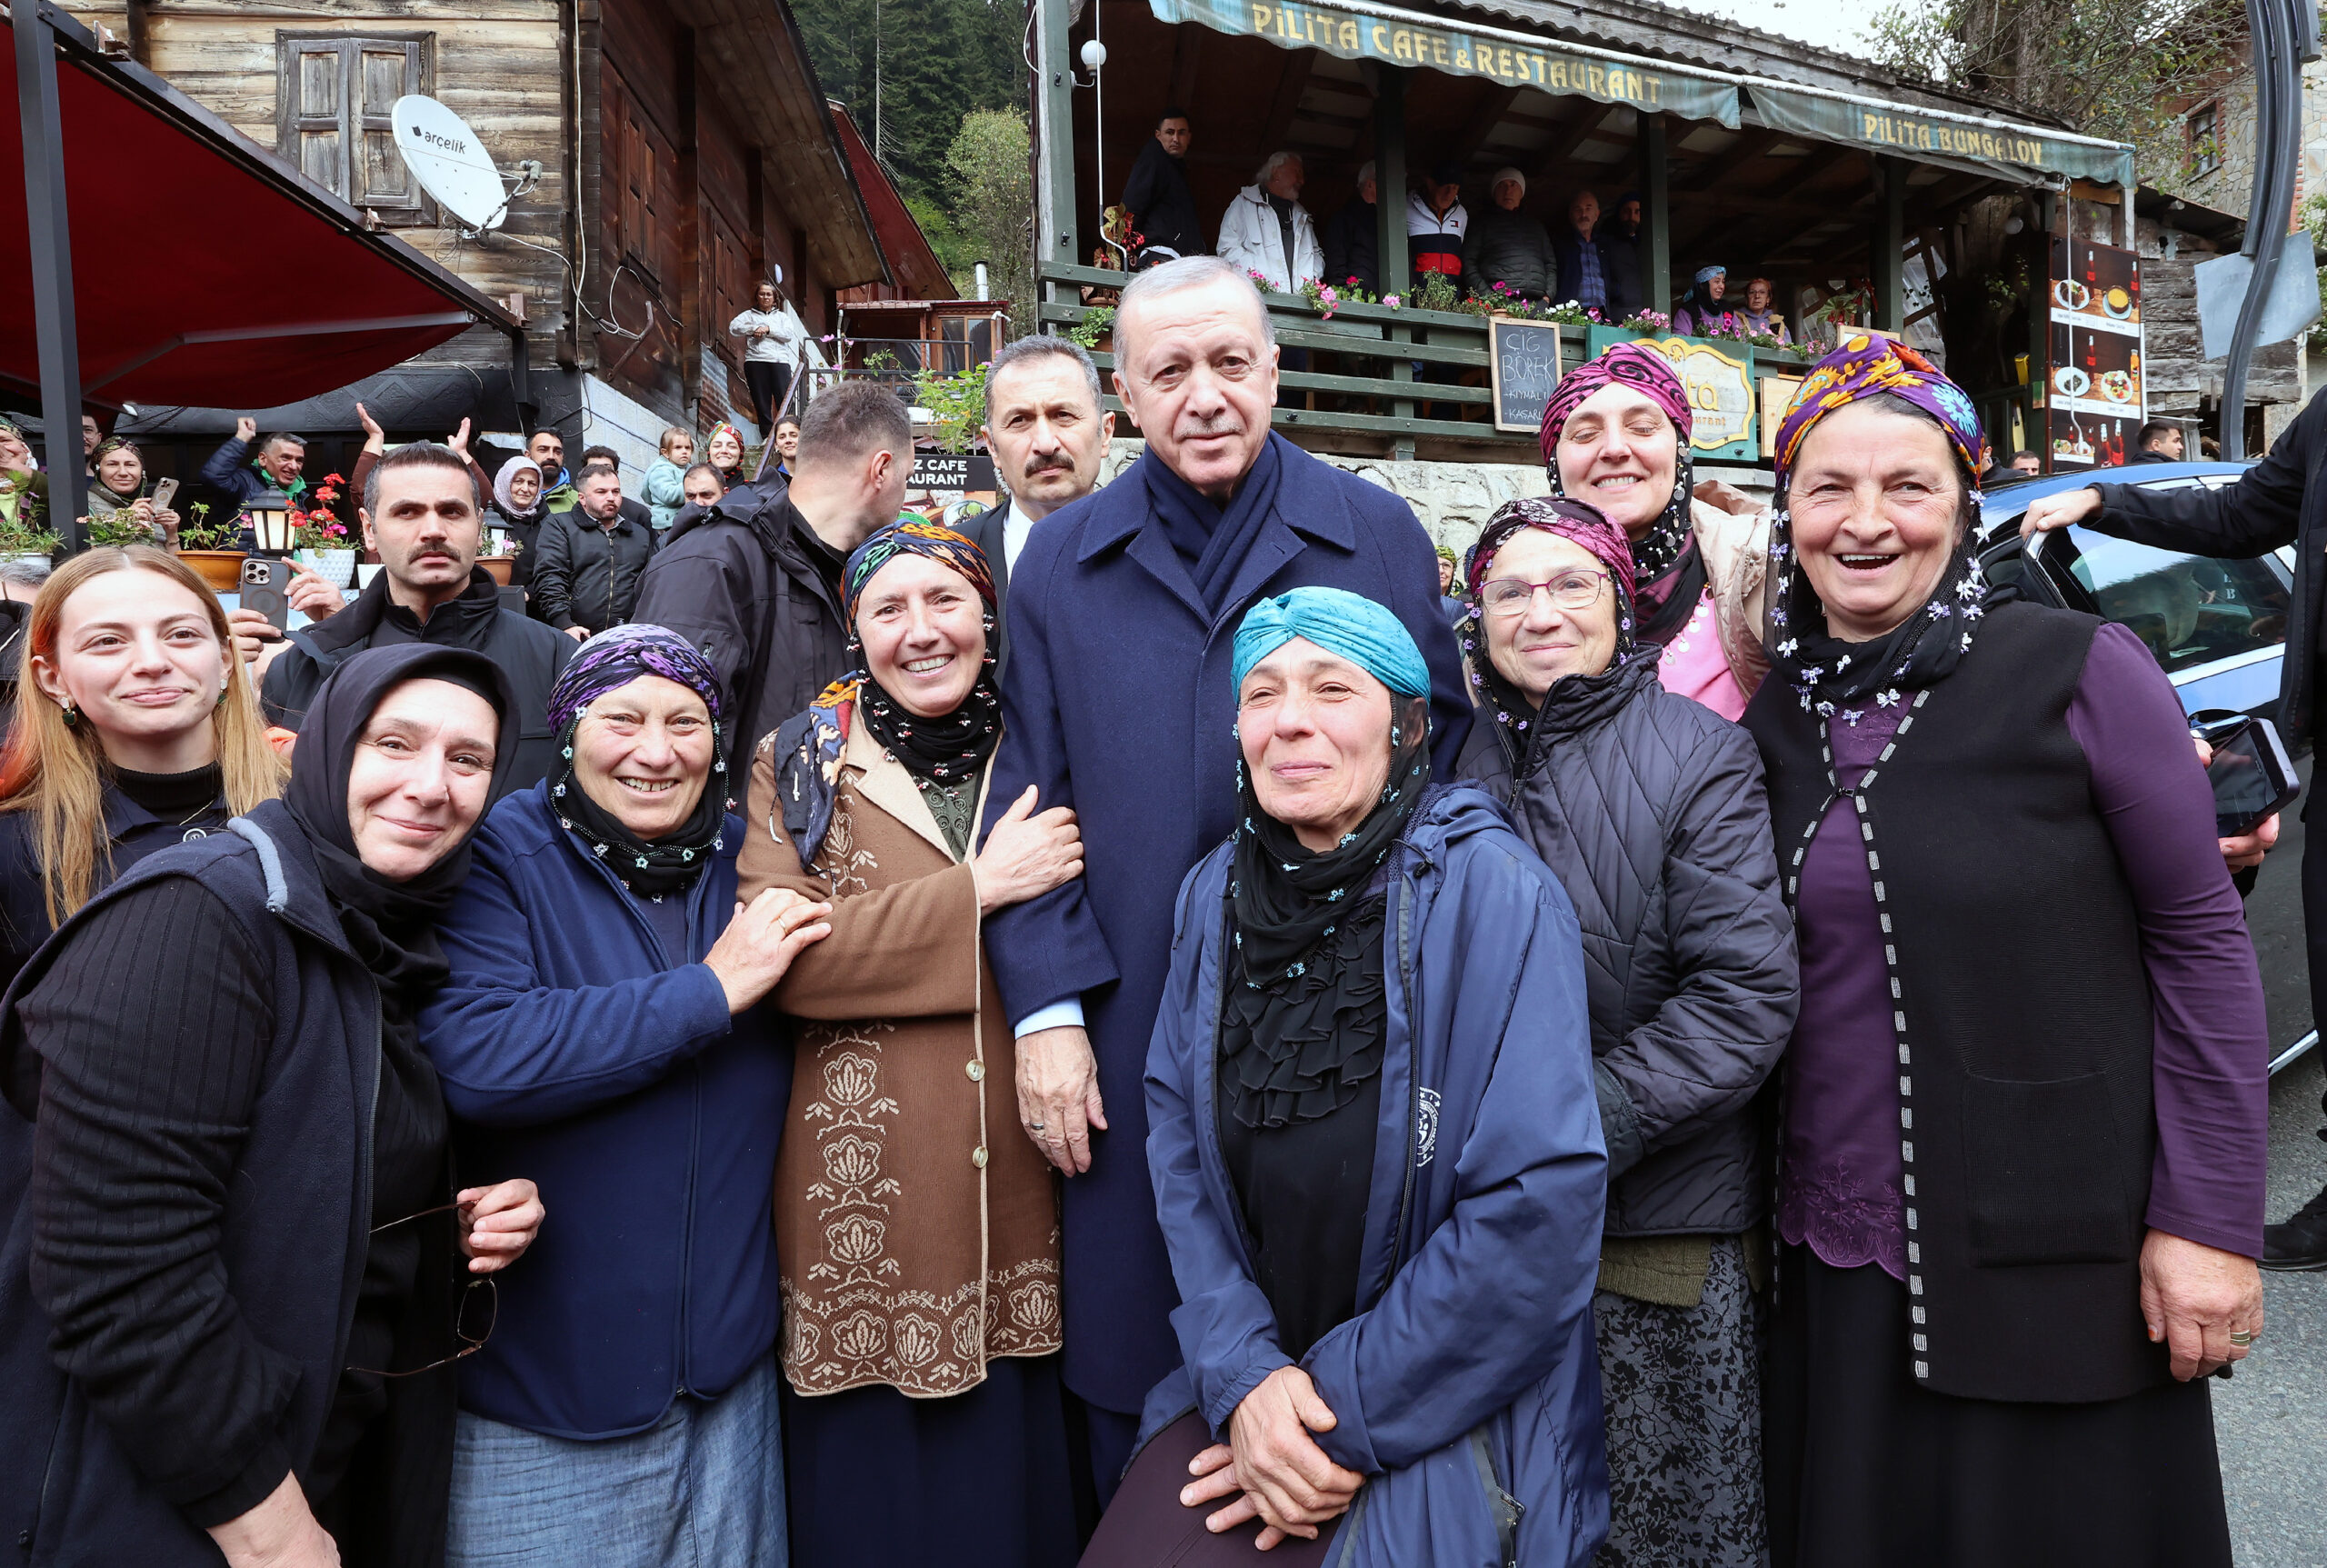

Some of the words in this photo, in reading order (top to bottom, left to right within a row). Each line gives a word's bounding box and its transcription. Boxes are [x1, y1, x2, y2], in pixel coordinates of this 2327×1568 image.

[1372, 25, 1449, 65] CAFE
[1475, 44, 1661, 104] RESTAURANT
[424, 131, 466, 155] arçelik
[1938, 125, 2042, 165] BUNGALOV
[1502, 351, 1555, 385] BÖREK
[906, 473, 967, 484] AURANT
[927, 459, 967, 471] CAFE
